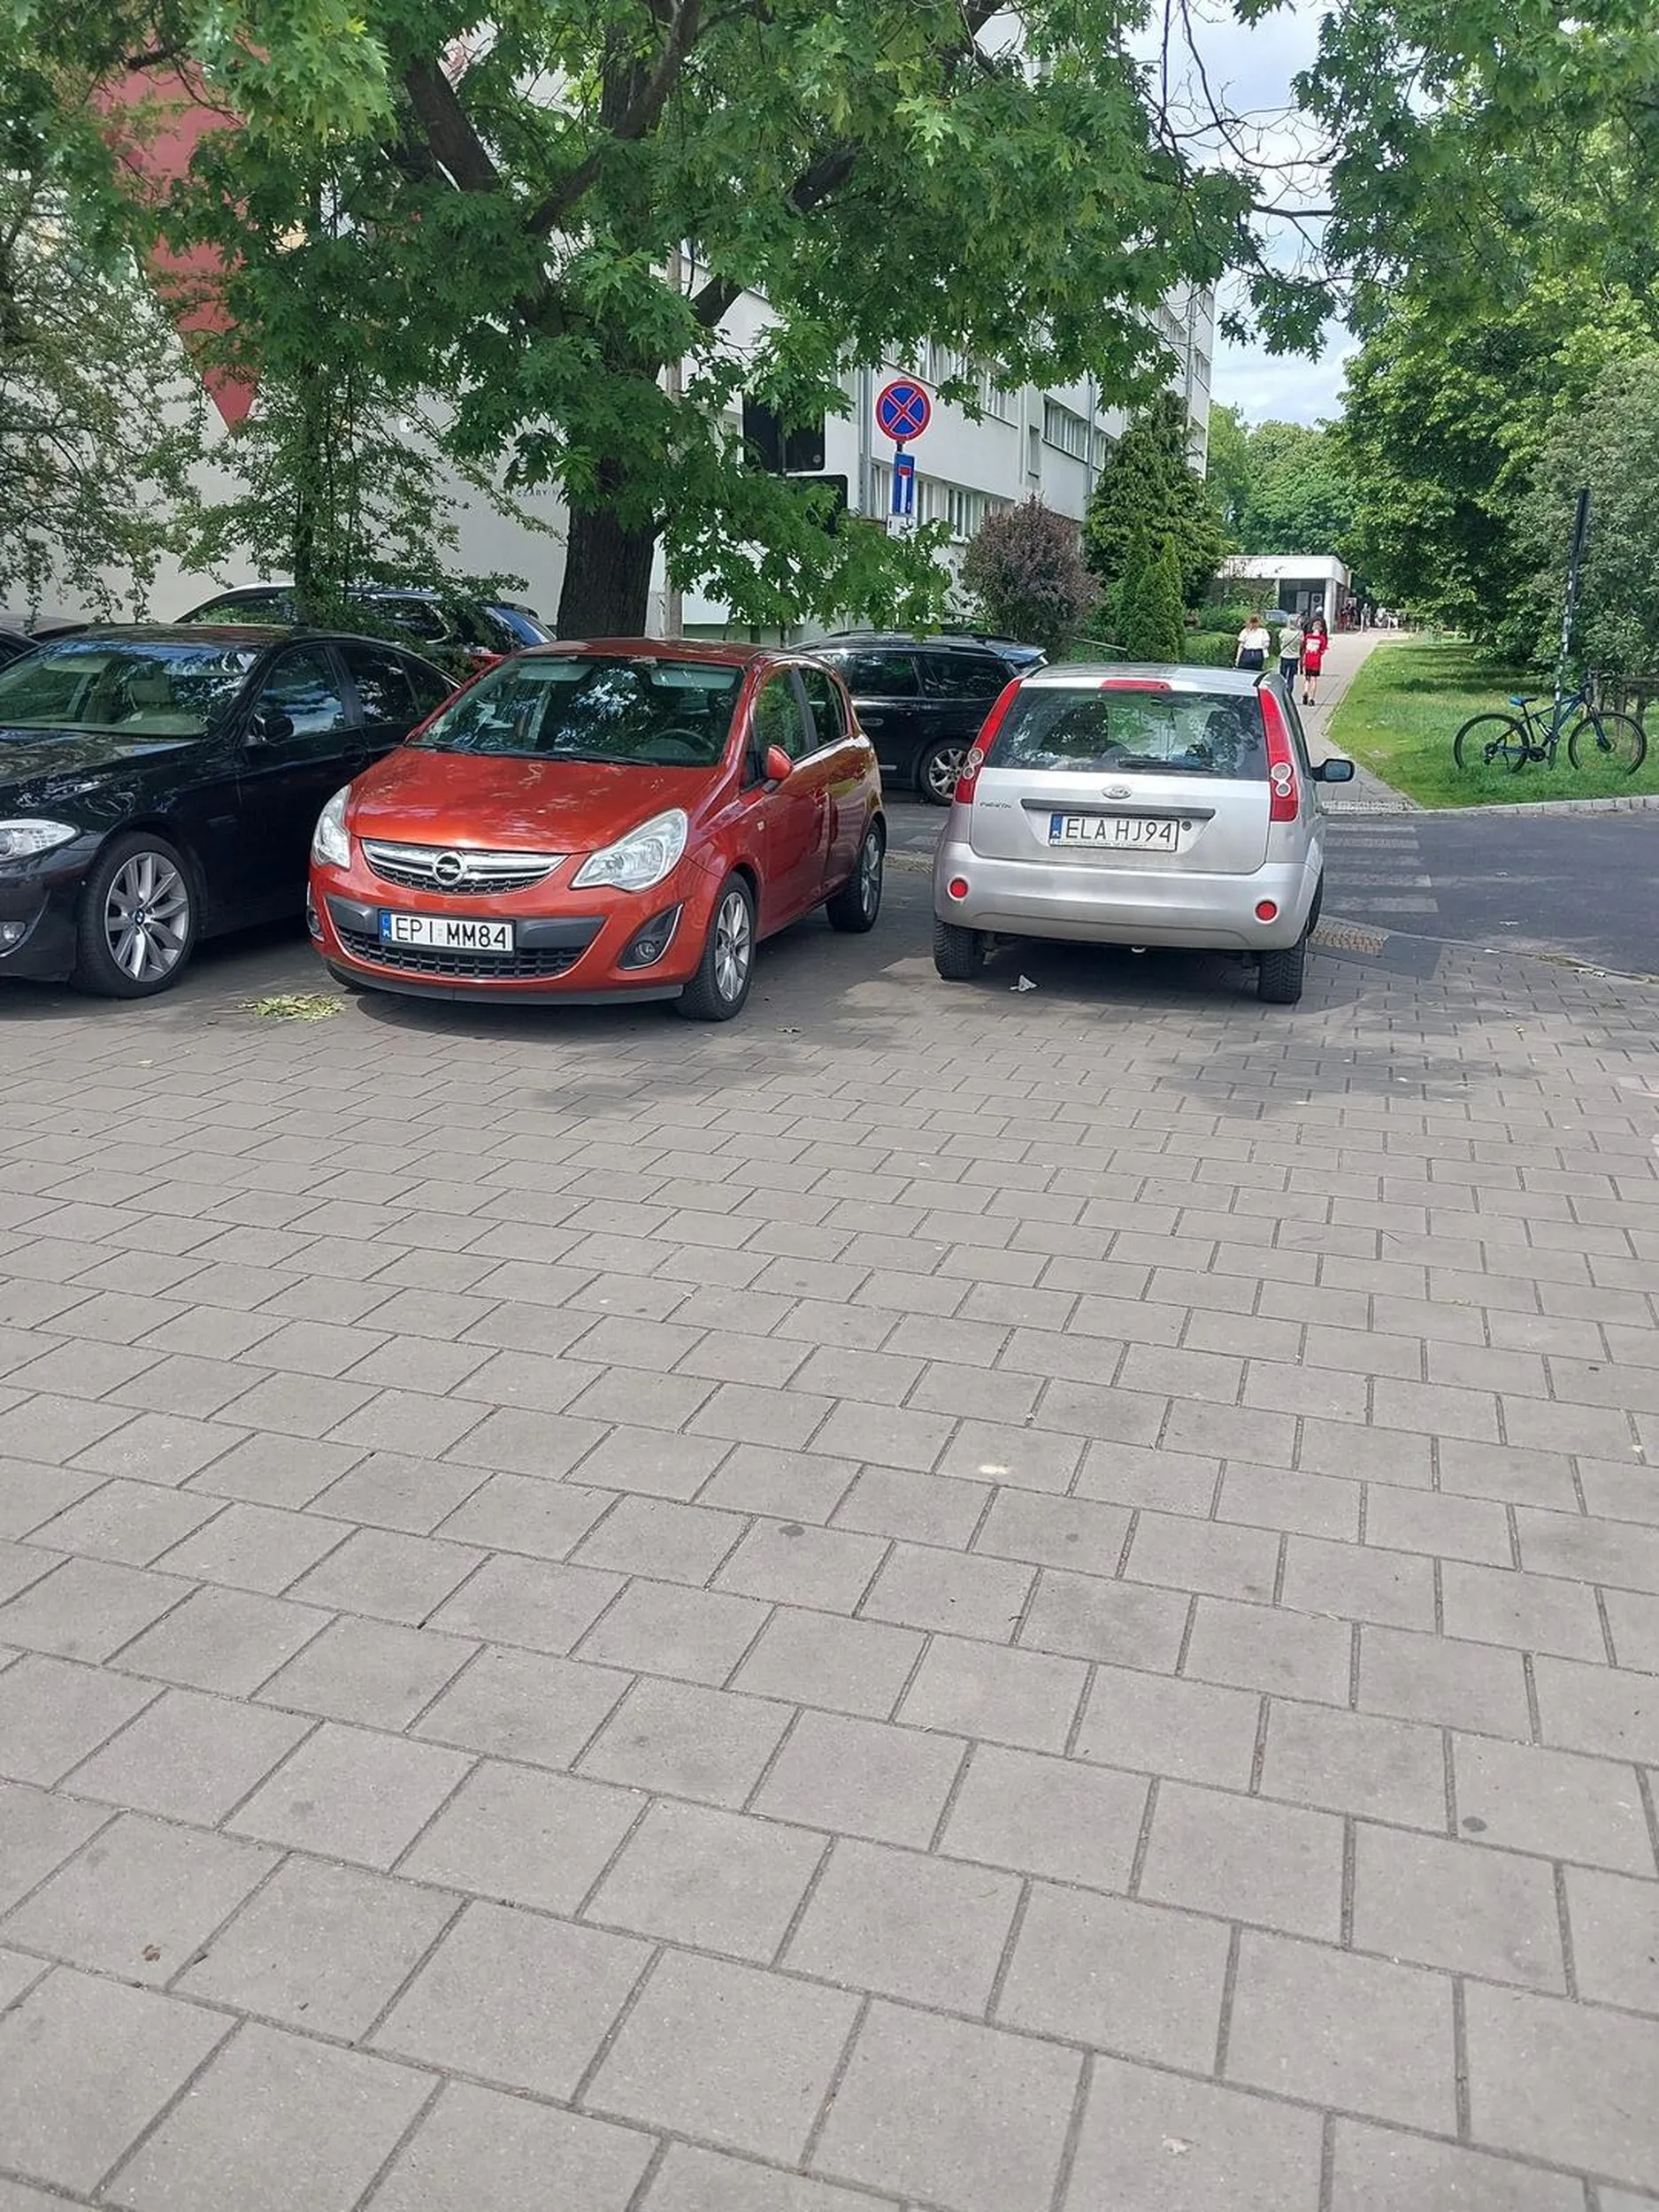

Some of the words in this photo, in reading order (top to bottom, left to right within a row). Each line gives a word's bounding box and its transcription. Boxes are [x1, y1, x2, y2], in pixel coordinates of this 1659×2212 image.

[1065, 818, 1107, 840] ELA
[1115, 819, 1172, 842] HJ94
[396, 918, 434, 944] EPI
[447, 921, 507, 949] MM84
